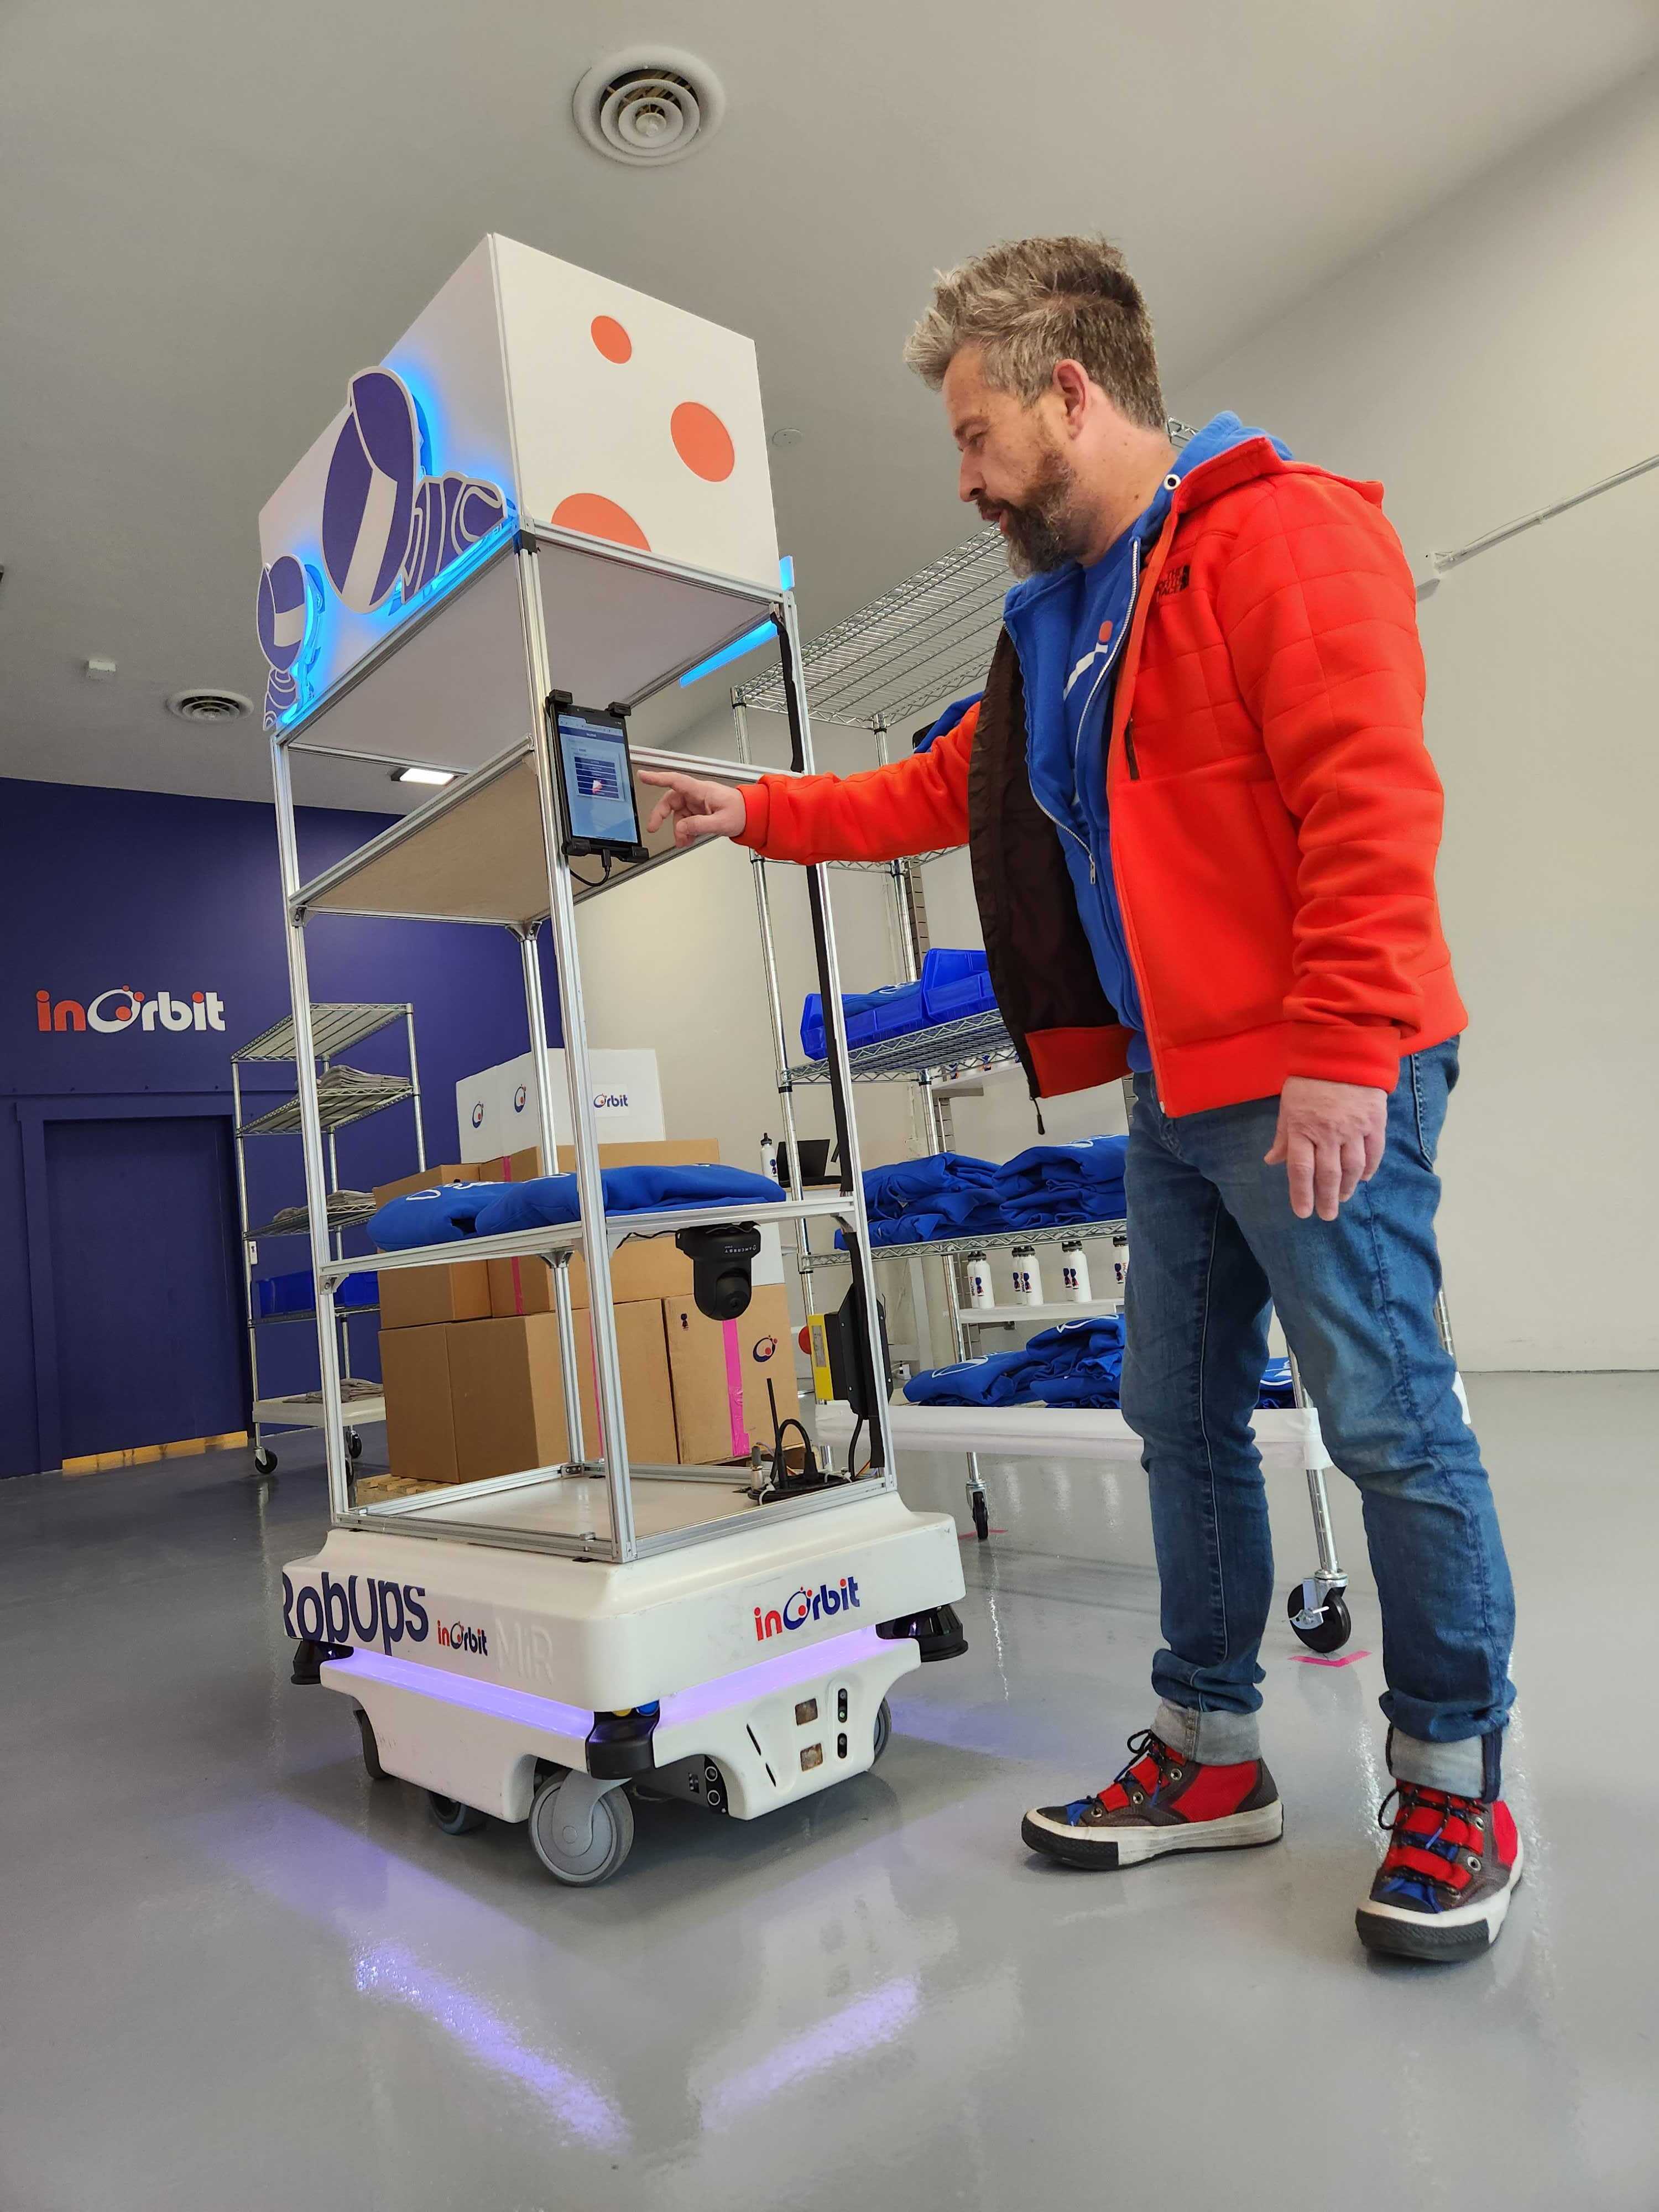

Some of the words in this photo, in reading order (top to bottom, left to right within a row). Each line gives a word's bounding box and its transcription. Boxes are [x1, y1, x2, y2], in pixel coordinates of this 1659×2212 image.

[35, 984, 226, 1034] inOrbit
[754, 1575, 860, 1641] inOrbit
[437, 1620, 488, 1656] inOrbit
